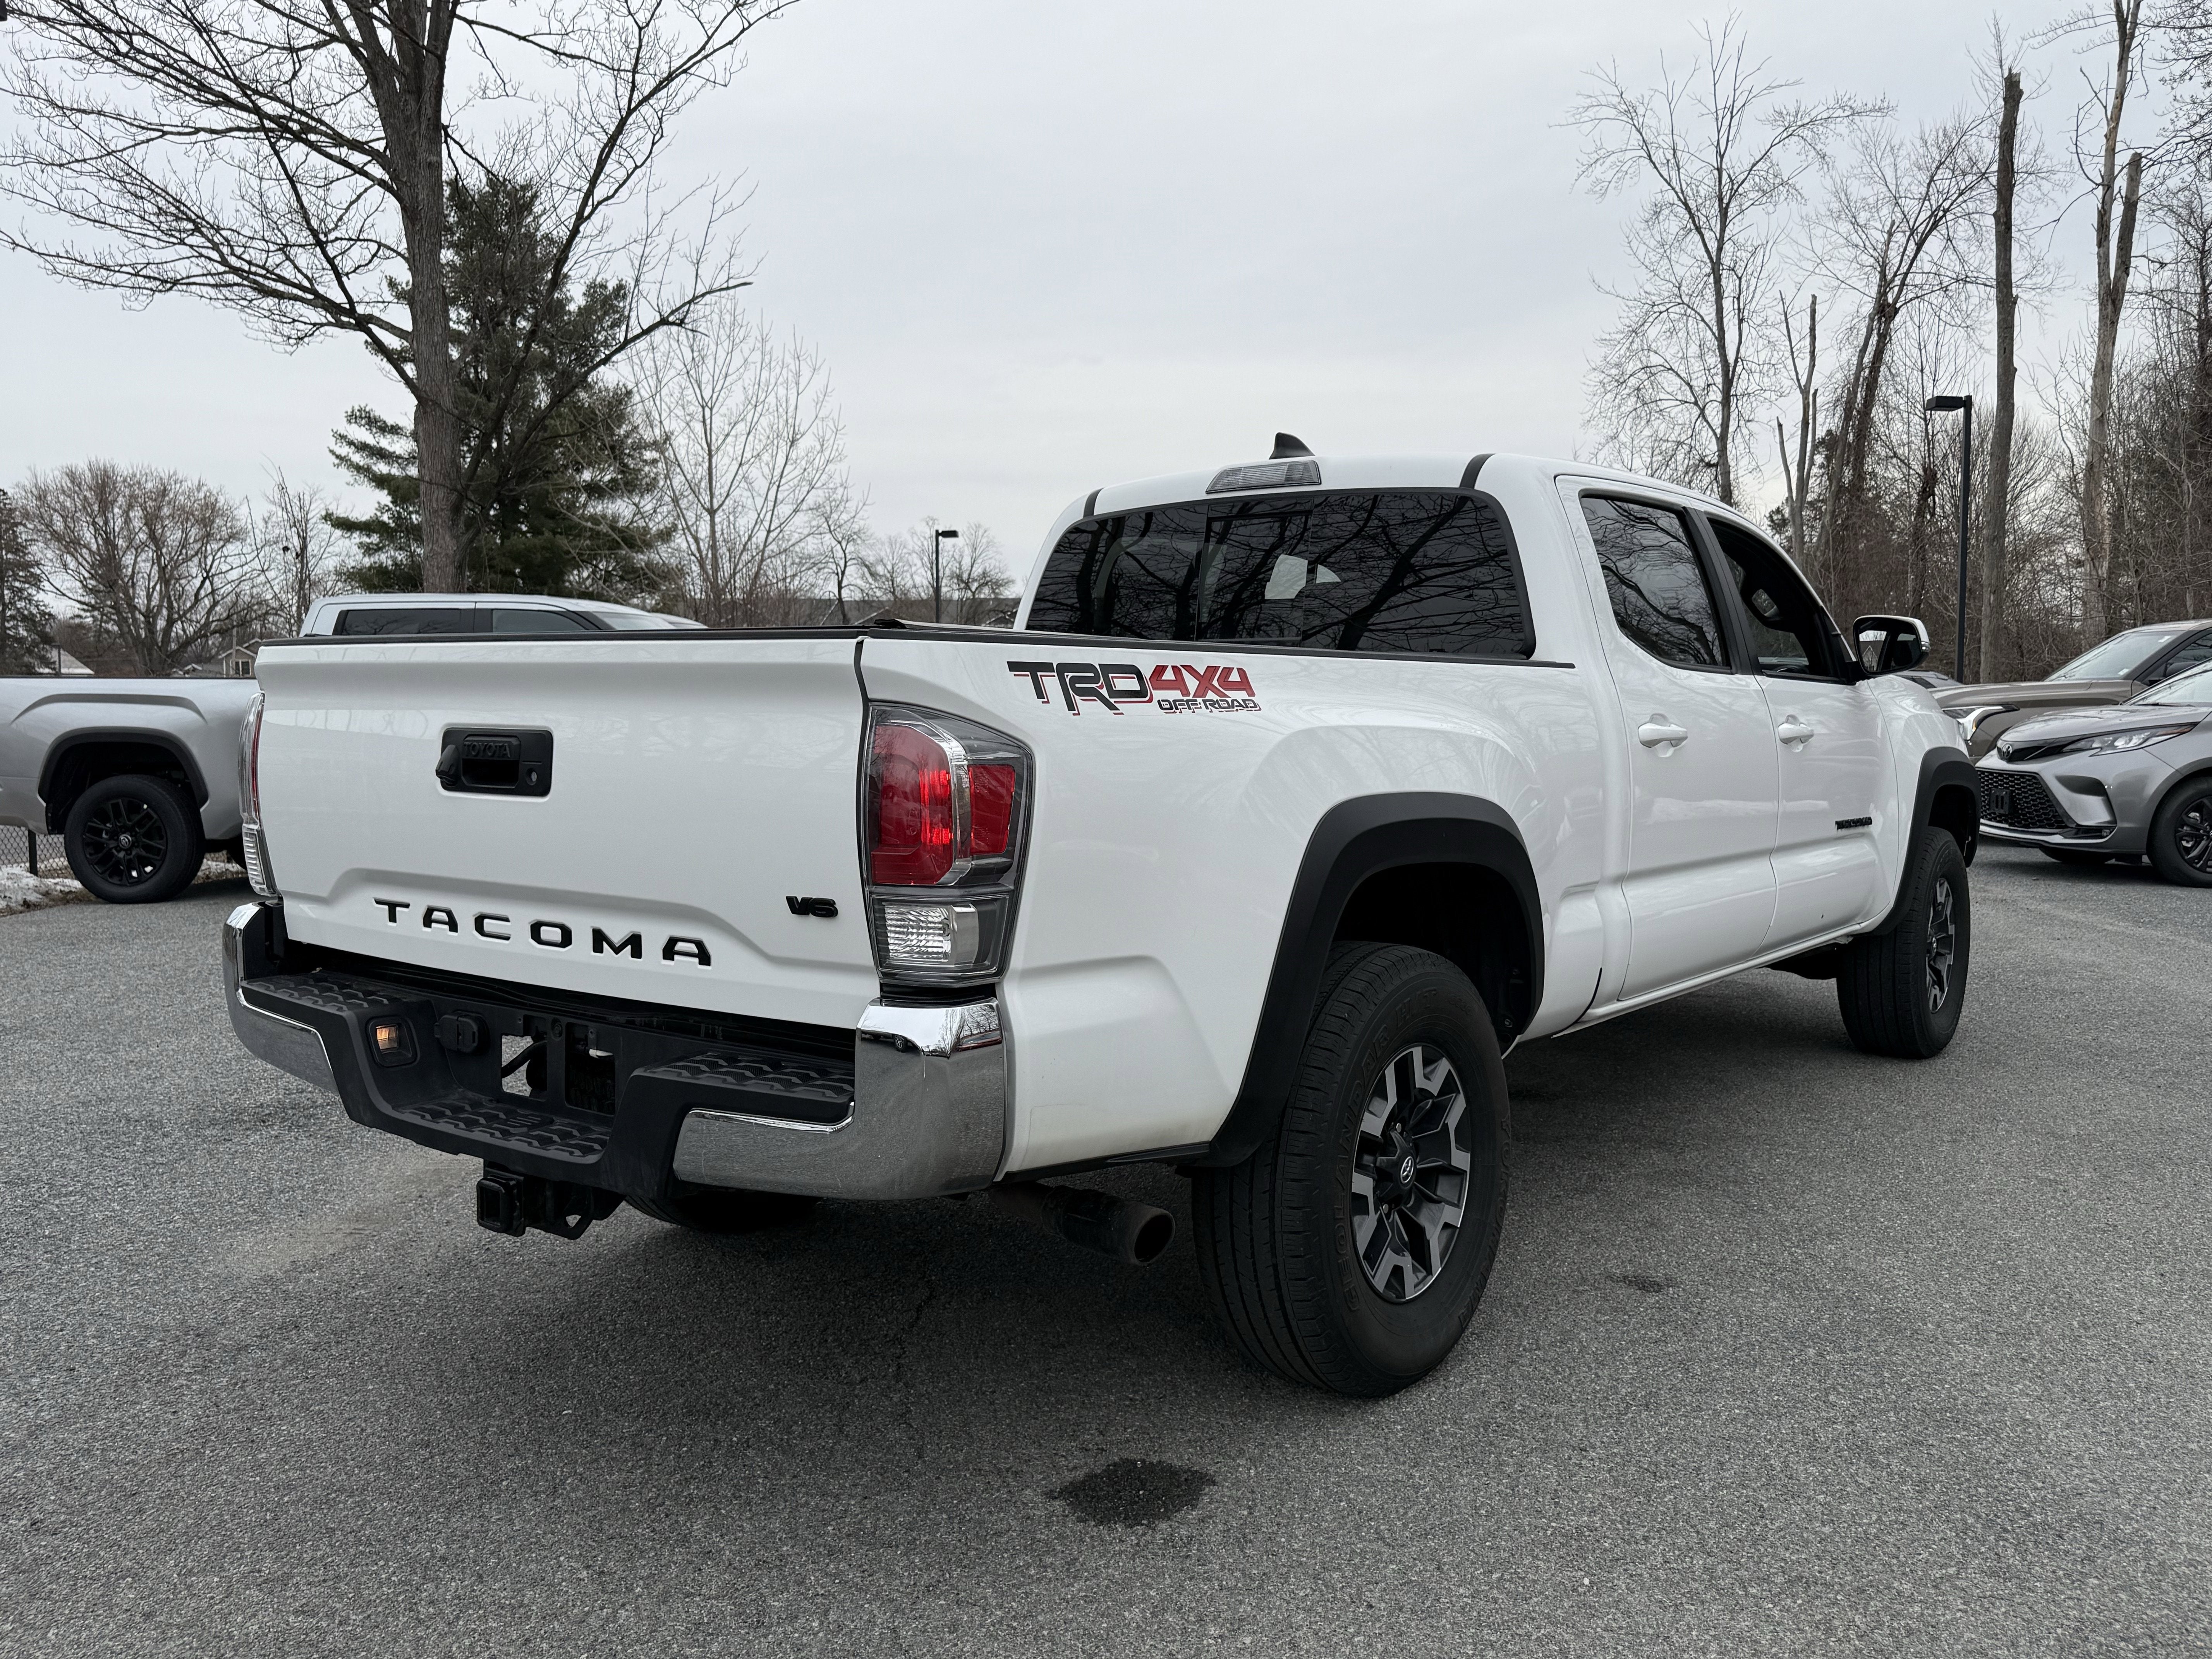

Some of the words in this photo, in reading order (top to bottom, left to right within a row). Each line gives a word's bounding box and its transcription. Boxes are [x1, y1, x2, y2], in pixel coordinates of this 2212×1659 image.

[1007, 661, 1154, 716] TRD
[464, 742, 510, 758] TOYOTA
[373, 898, 712, 967] TACOMA
[786, 896, 838, 917] V6
[1334, 1024, 1390, 1312] GEOLANDAR
